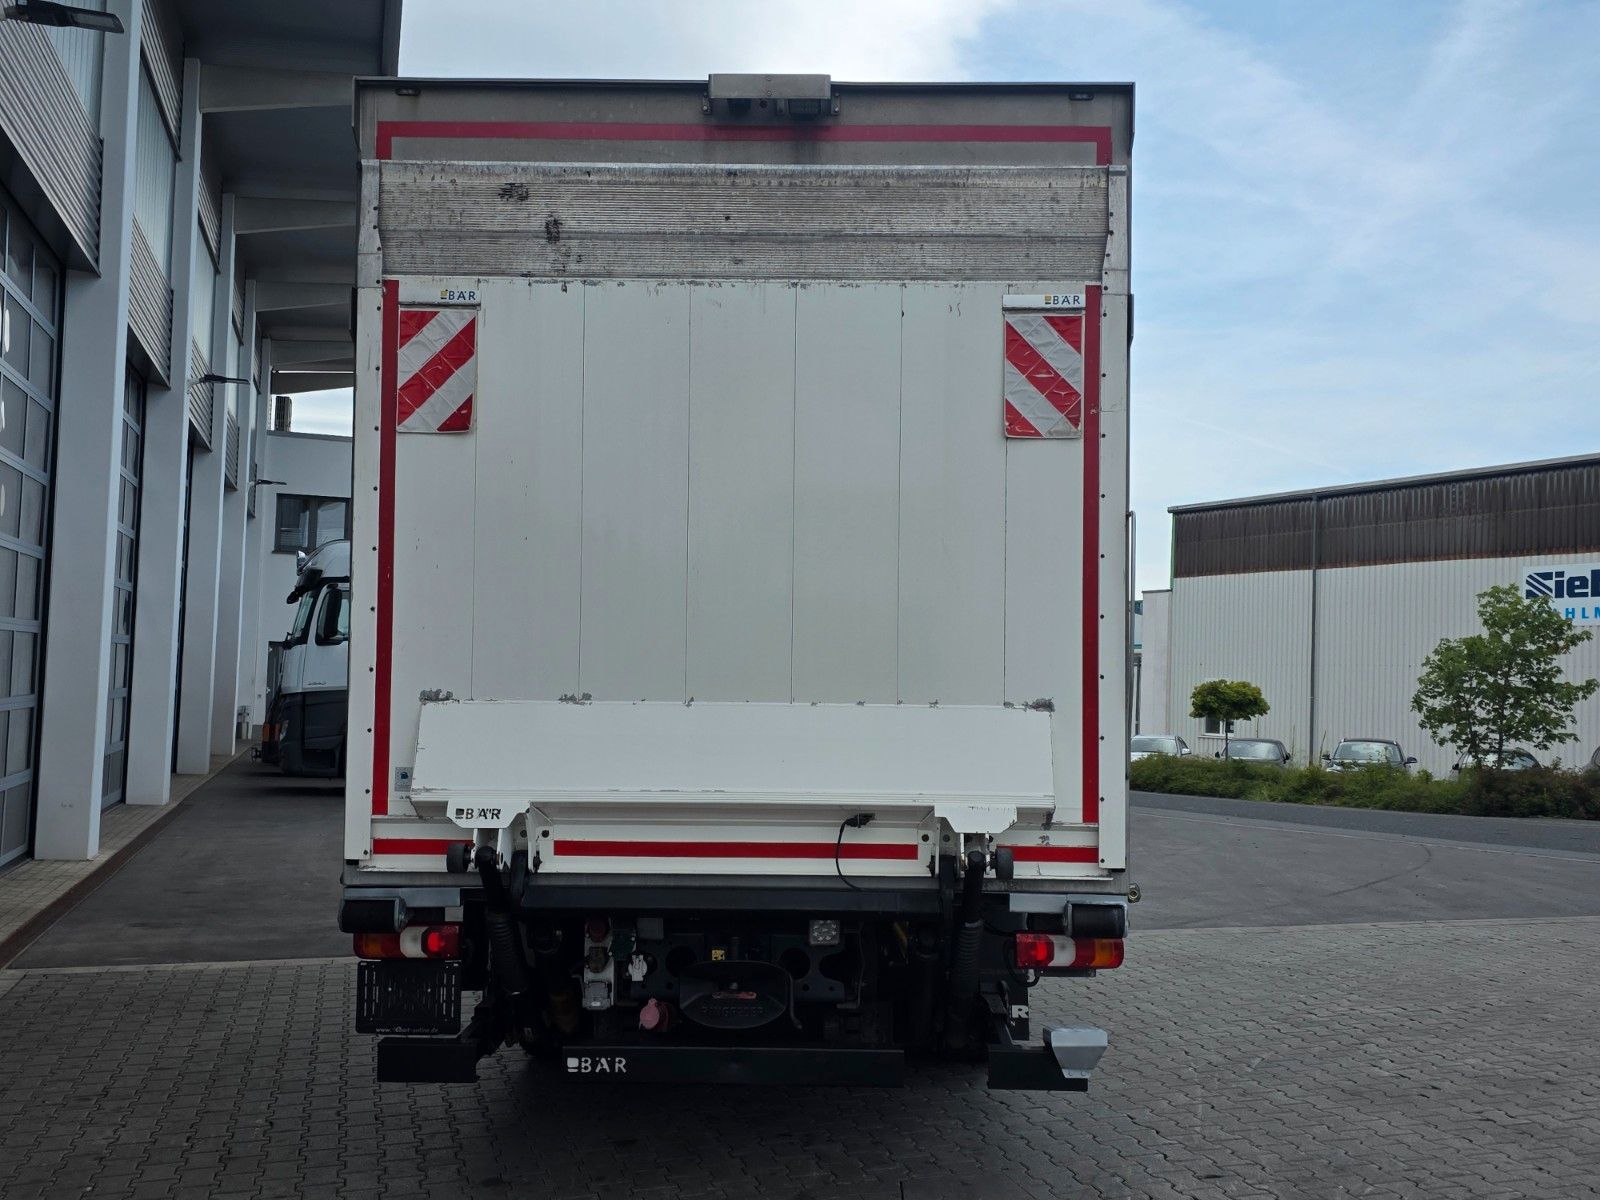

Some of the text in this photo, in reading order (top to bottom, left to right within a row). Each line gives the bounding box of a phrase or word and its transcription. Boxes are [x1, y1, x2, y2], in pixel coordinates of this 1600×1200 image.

[448, 290, 476, 301] BÄR
[1052, 295, 1081, 305] BÄR
[581, 1057, 627, 1073] BÄR
